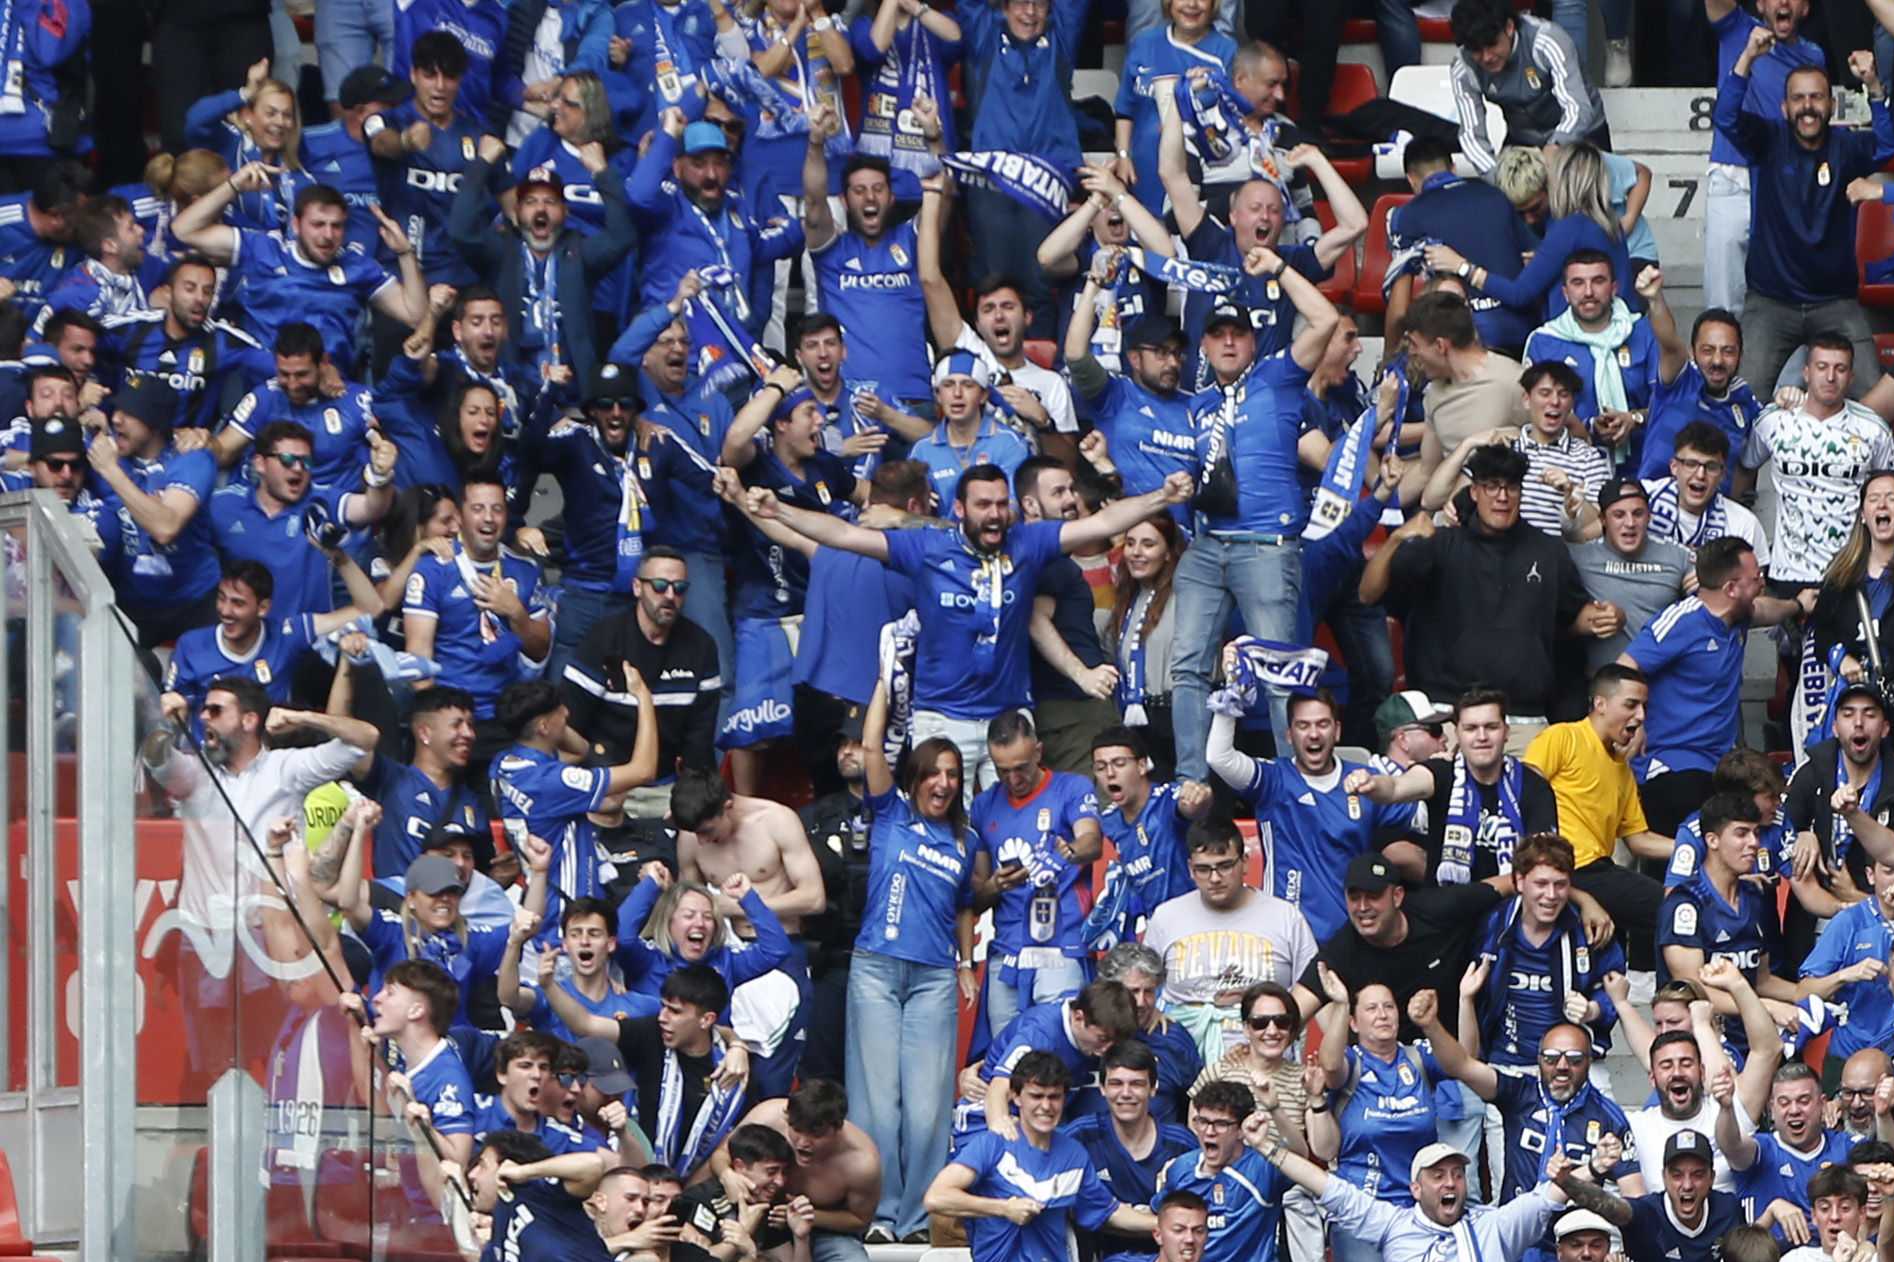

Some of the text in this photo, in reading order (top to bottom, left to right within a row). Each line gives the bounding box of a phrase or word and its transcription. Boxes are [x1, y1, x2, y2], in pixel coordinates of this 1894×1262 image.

[1689, 99, 1711, 132] 8
[1667, 180, 1698, 219] 7
[1153, 428, 1199, 453] NMR
[1781, 461, 1859, 480] DIGI
[956, 590, 1016, 609] OVO
[916, 844, 962, 877] NMR
[887, 873, 903, 925] OVIEDO
